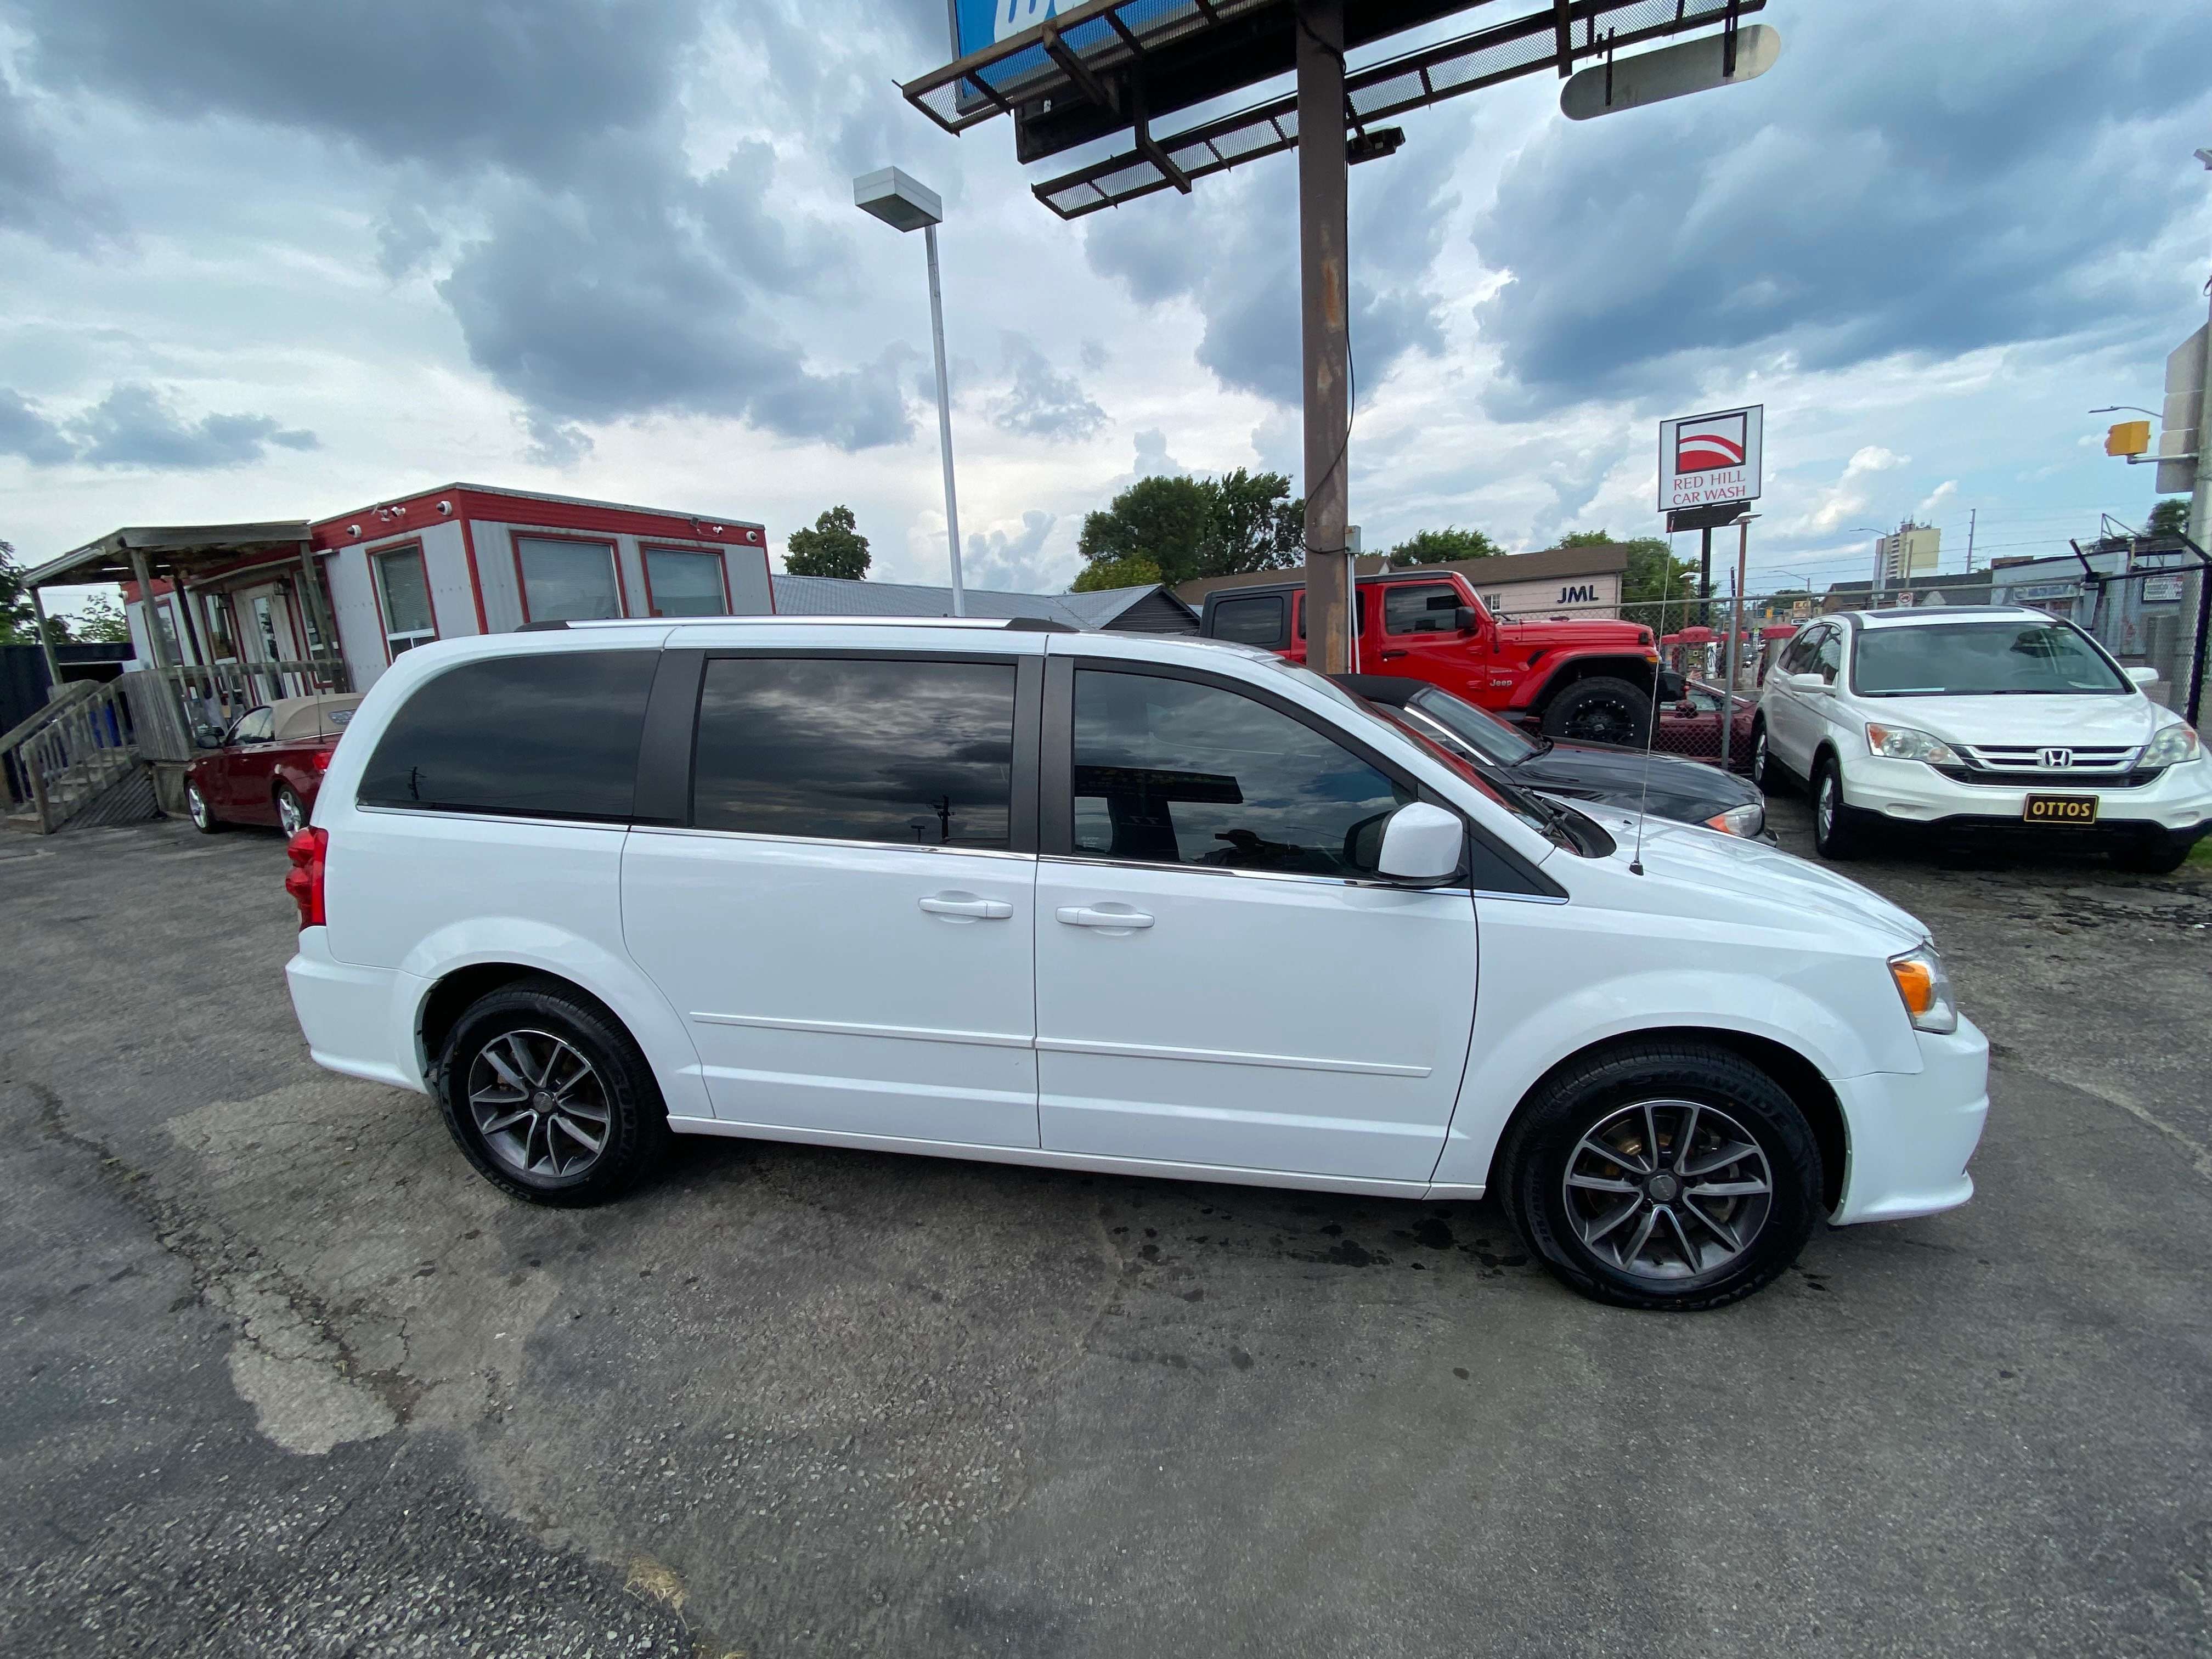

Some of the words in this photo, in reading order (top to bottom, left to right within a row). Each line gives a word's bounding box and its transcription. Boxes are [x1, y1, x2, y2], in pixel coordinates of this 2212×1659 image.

[1673, 476, 1703, 491] RED
[1711, 470, 1746, 486] HILL
[1673, 492, 1700, 505] CAR
[1703, 485, 1746, 500] WASH
[1557, 585, 1599, 603] JML
[2032, 802, 2090, 817] OTTOS
